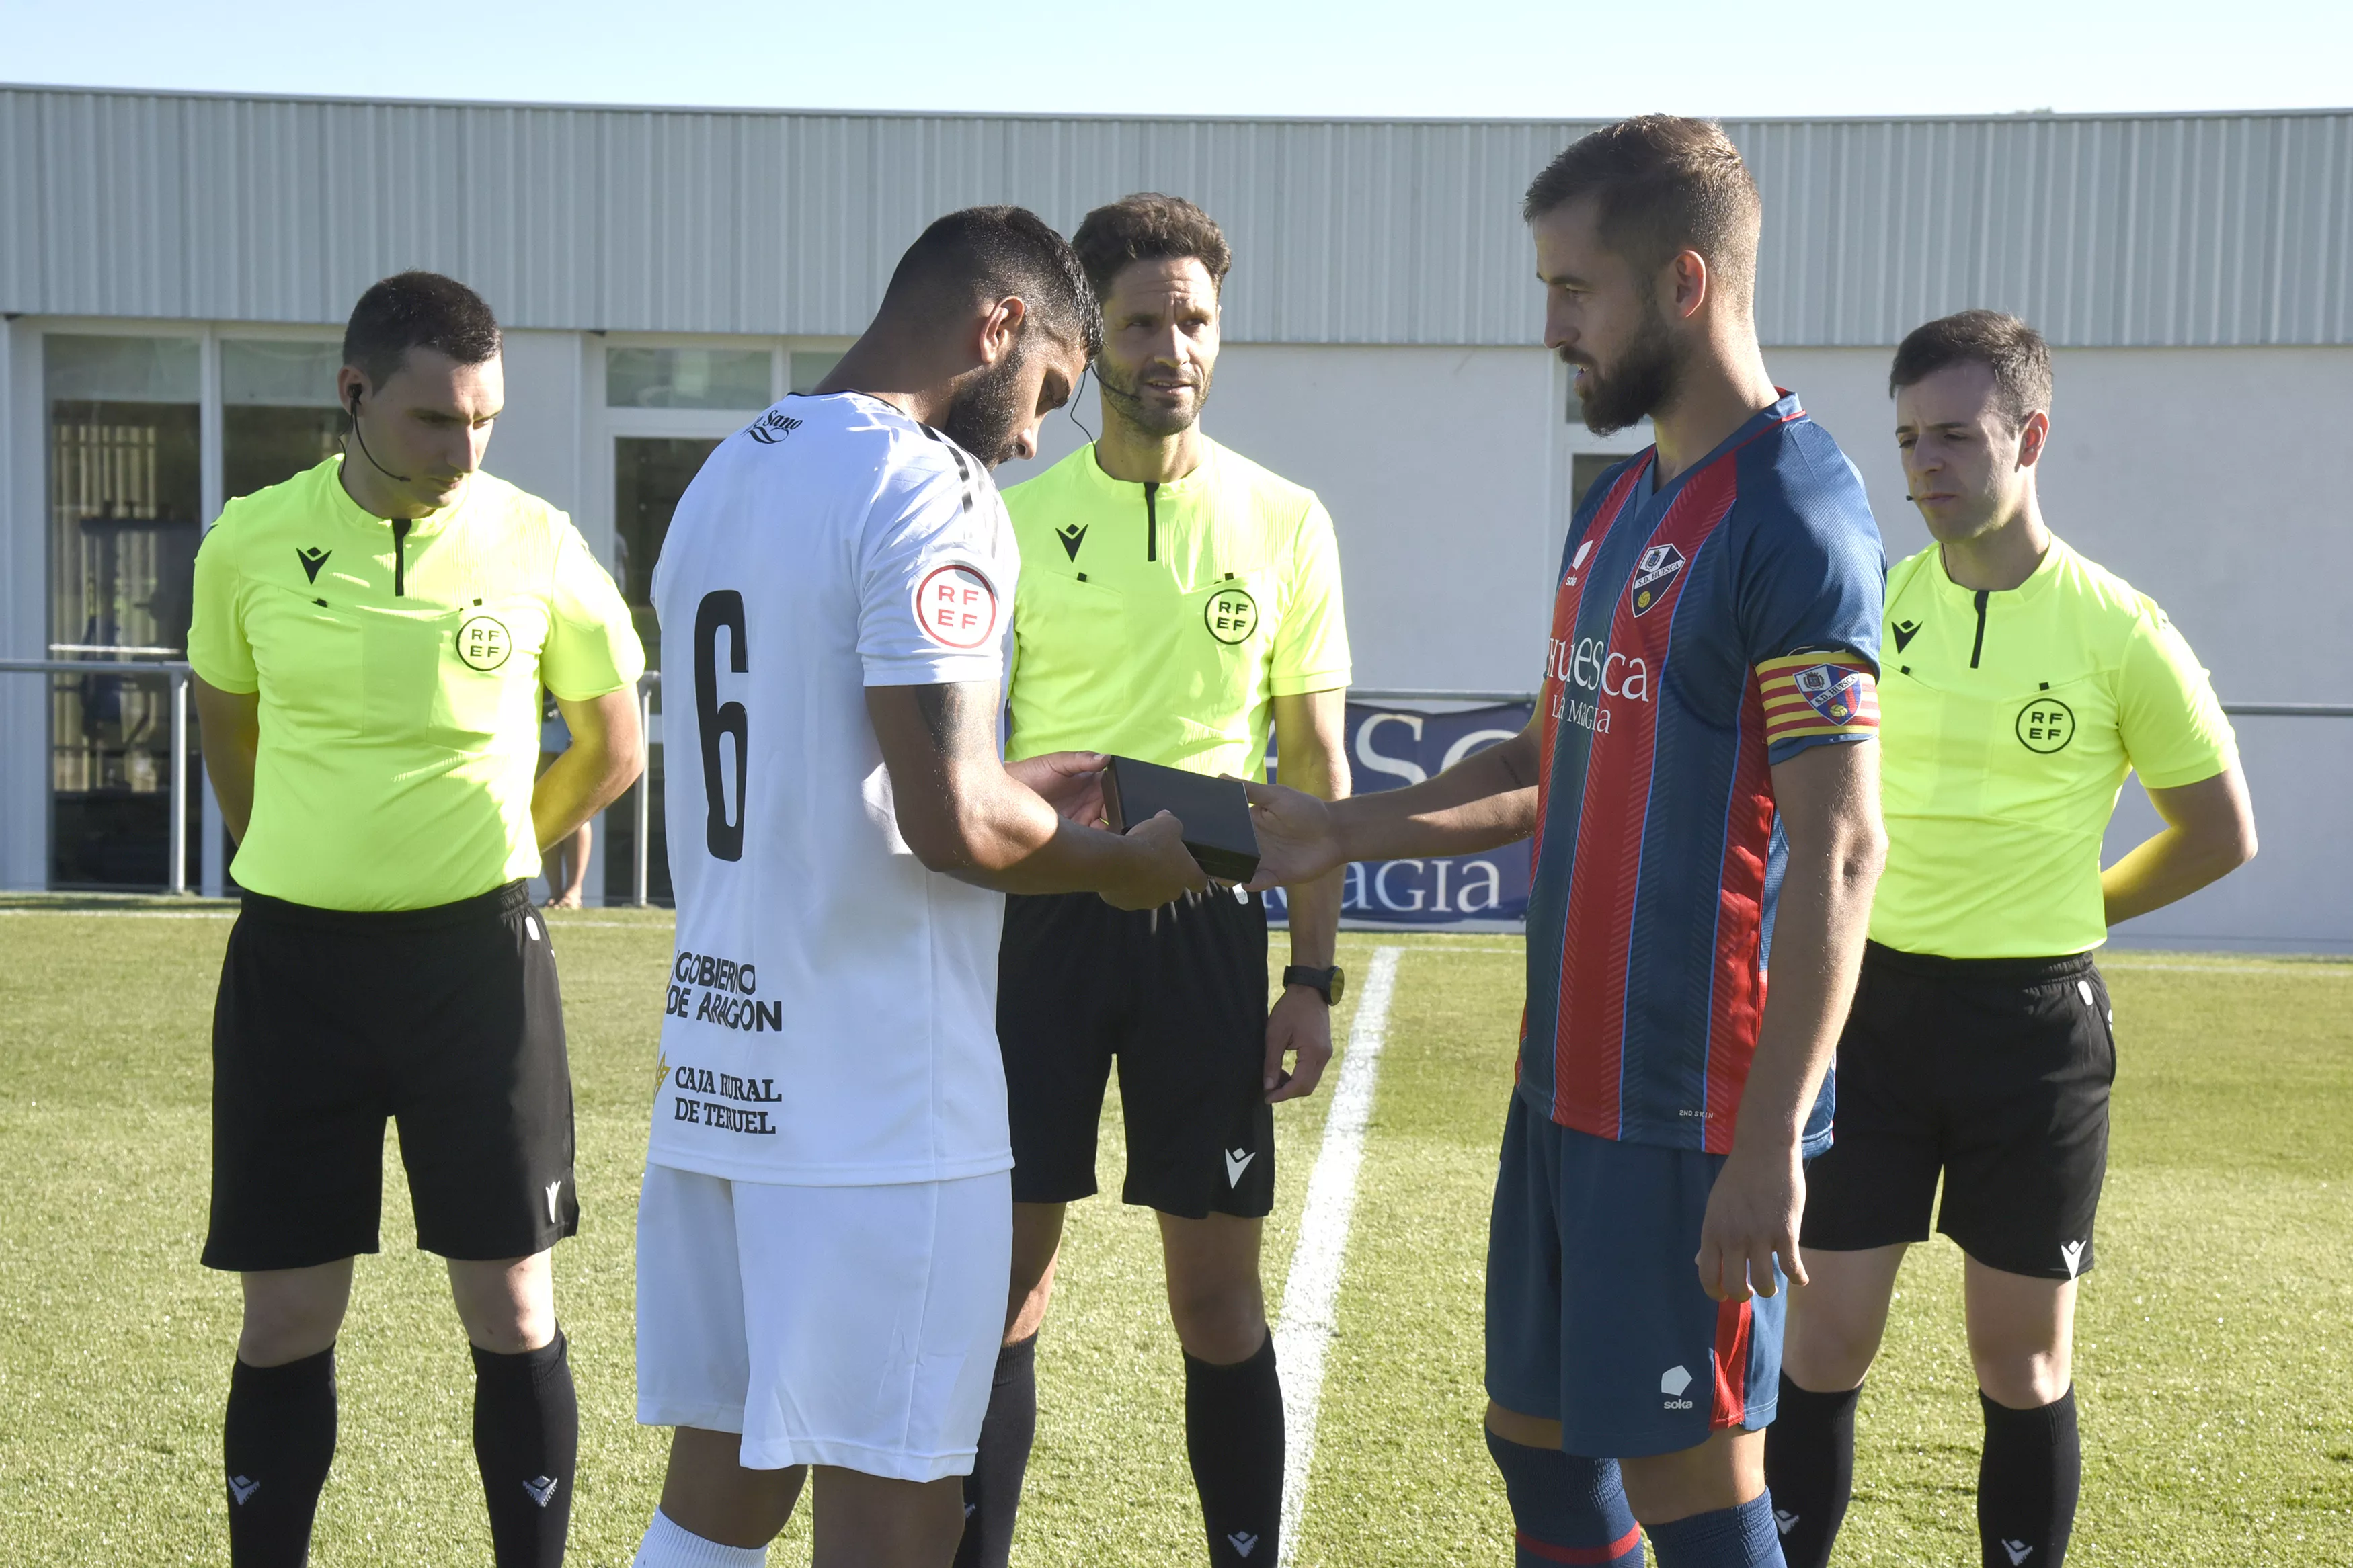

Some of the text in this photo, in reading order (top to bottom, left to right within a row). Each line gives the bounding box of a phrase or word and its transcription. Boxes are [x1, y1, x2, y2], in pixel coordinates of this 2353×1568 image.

[762, 409, 803, 430] Sano
[1638, 562, 1679, 586] S.D. HUESCA
[938, 585, 979, 605] RF
[1218, 601, 1248, 615] RF
[937, 608, 978, 630] EF
[1216, 616, 1246, 631] EF
[471, 629, 500, 641] RF
[469, 645, 500, 658] EF
[1814, 675, 1856, 705] S.D. HUESCA
[694, 589, 749, 862] 6
[2031, 711, 2063, 725] RF
[2029, 727, 2061, 741] EF
[676, 952, 756, 995] GOBIERNO
[666, 985, 782, 1032] DE ARAGON
[675, 1066, 782, 1102] CAJA RURAL
[674, 1097, 776, 1134] DE TERUEL
[1694, 1110, 1714, 1119] SKIN
[1663, 1399, 1693, 1409] soka
